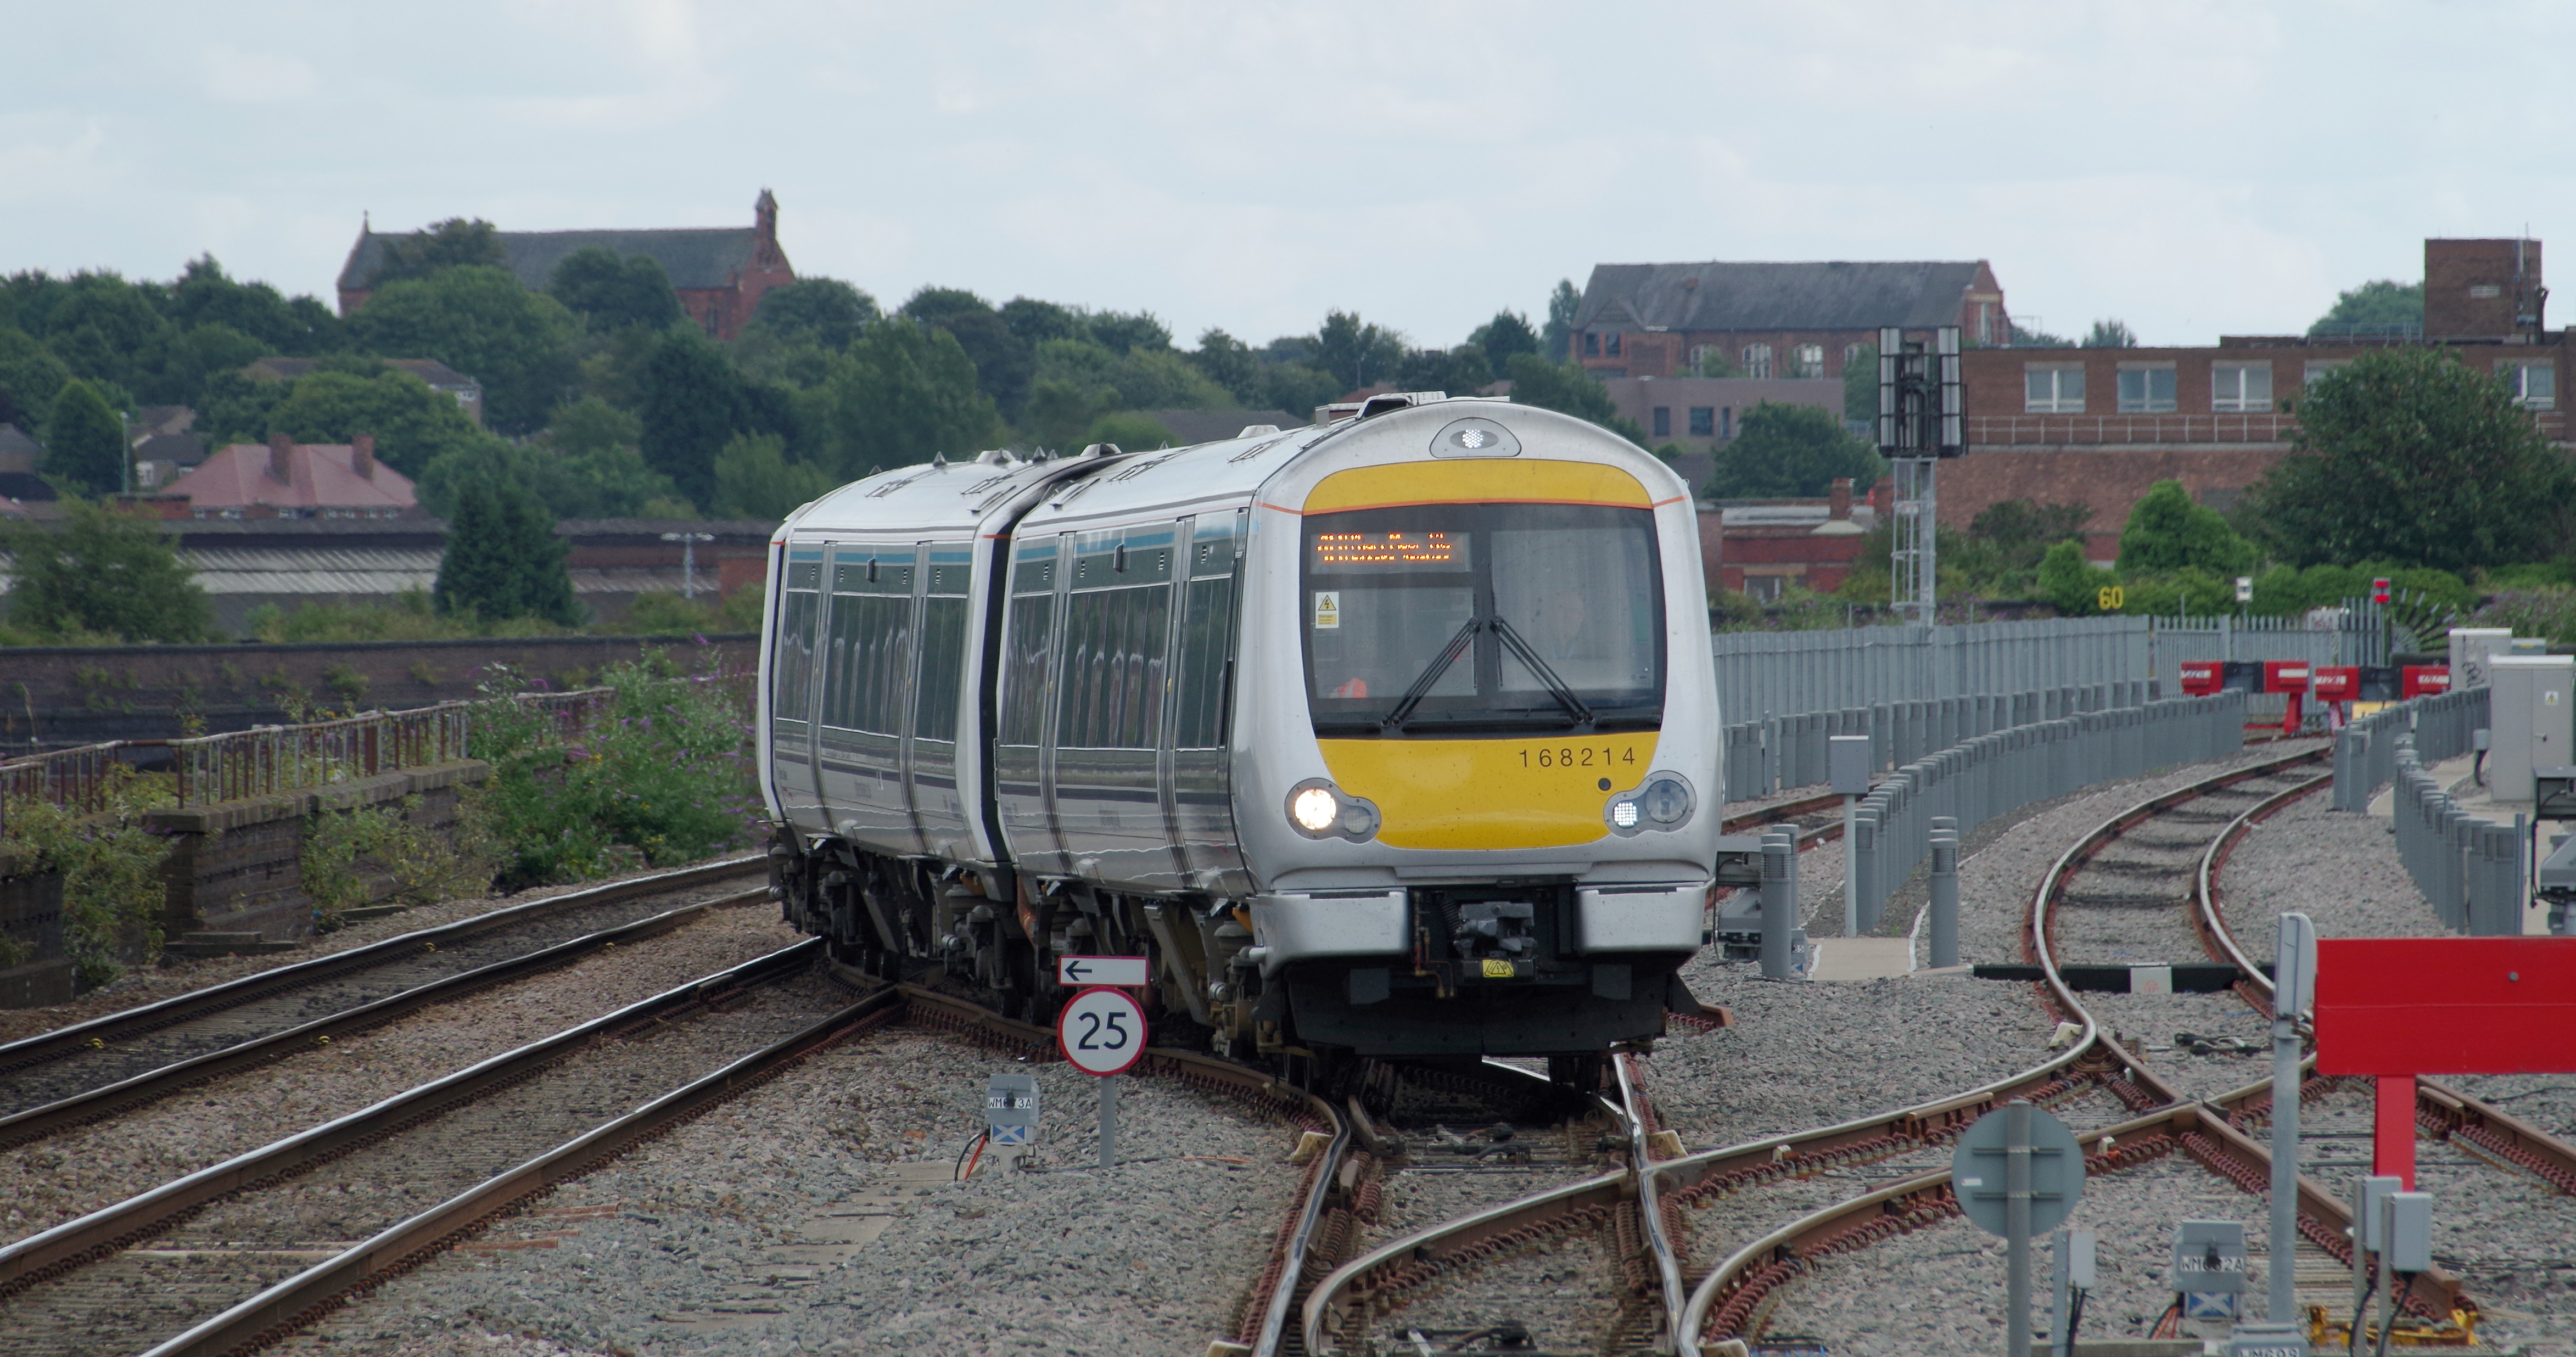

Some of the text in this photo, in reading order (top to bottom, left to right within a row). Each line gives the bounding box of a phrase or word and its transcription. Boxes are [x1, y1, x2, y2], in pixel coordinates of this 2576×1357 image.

[2098, 586, 2123, 610] 60
[1519, 747, 1635, 767] 168214
[1078, 1012, 1127, 1050] 25
[988, 1098, 1032, 1108] WM63A
